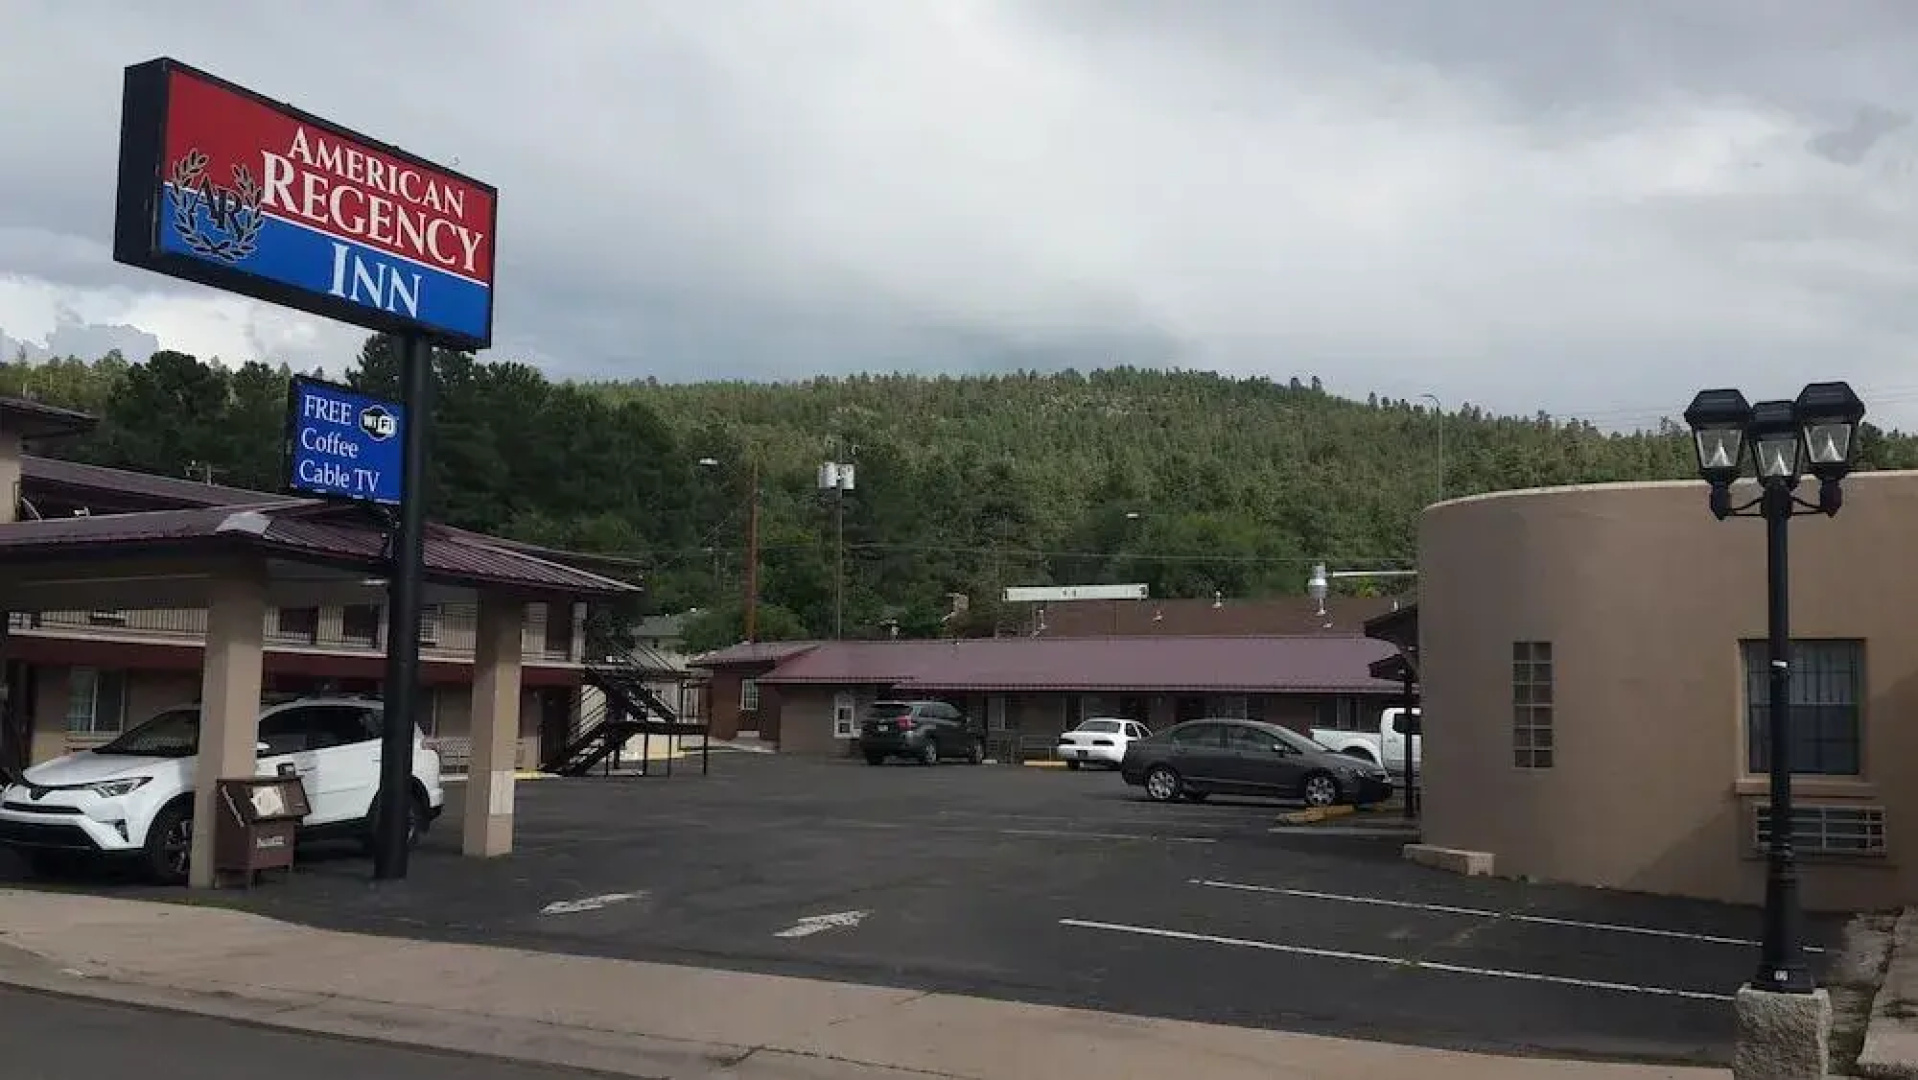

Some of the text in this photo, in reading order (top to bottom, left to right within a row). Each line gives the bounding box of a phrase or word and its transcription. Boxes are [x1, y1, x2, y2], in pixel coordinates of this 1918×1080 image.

[287, 126, 465, 219] AMERICAN
[261, 151, 484, 273] REGENCY
[327, 241, 423, 319] INN
[304, 394, 352, 425] FREE
[302, 427, 359, 458] Coffee
[300, 459, 380, 492] Cable TV
